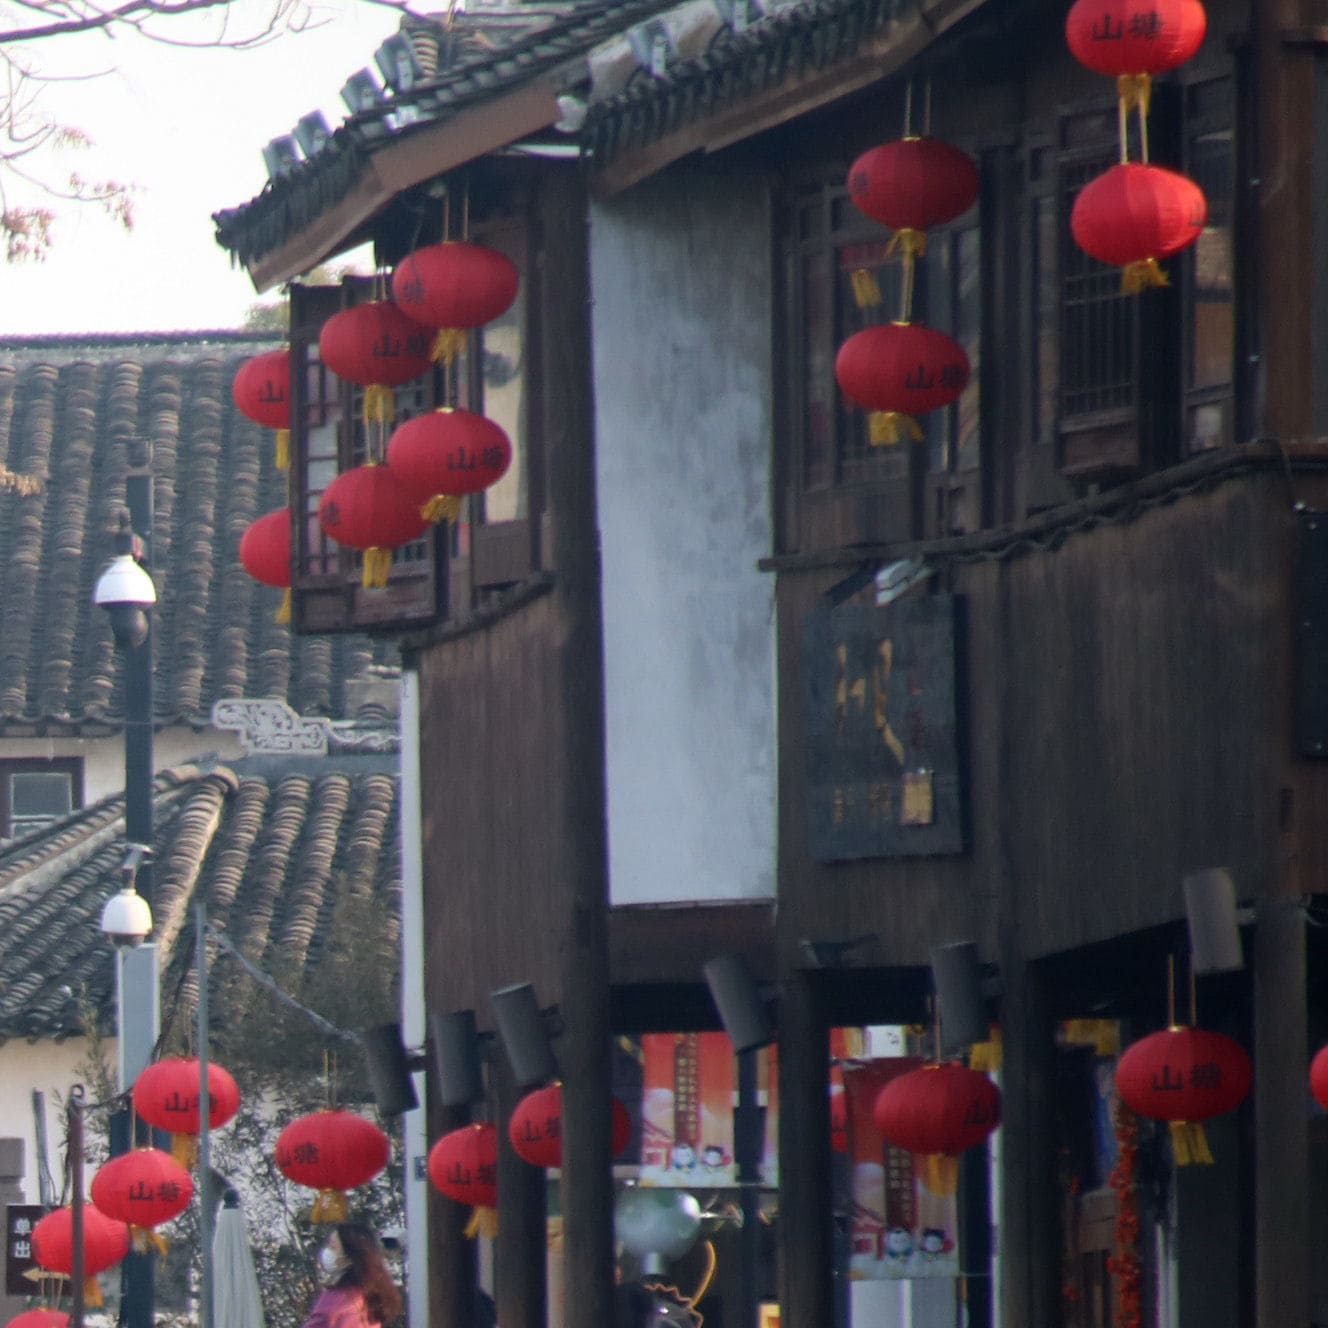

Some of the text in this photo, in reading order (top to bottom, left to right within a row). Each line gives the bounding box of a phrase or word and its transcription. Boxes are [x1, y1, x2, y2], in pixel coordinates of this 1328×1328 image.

[1091, 9, 1164, 41] 山塘
[1152, 1062, 1222, 1091] 山塘
[128, 1181, 181, 1202] 山塘
